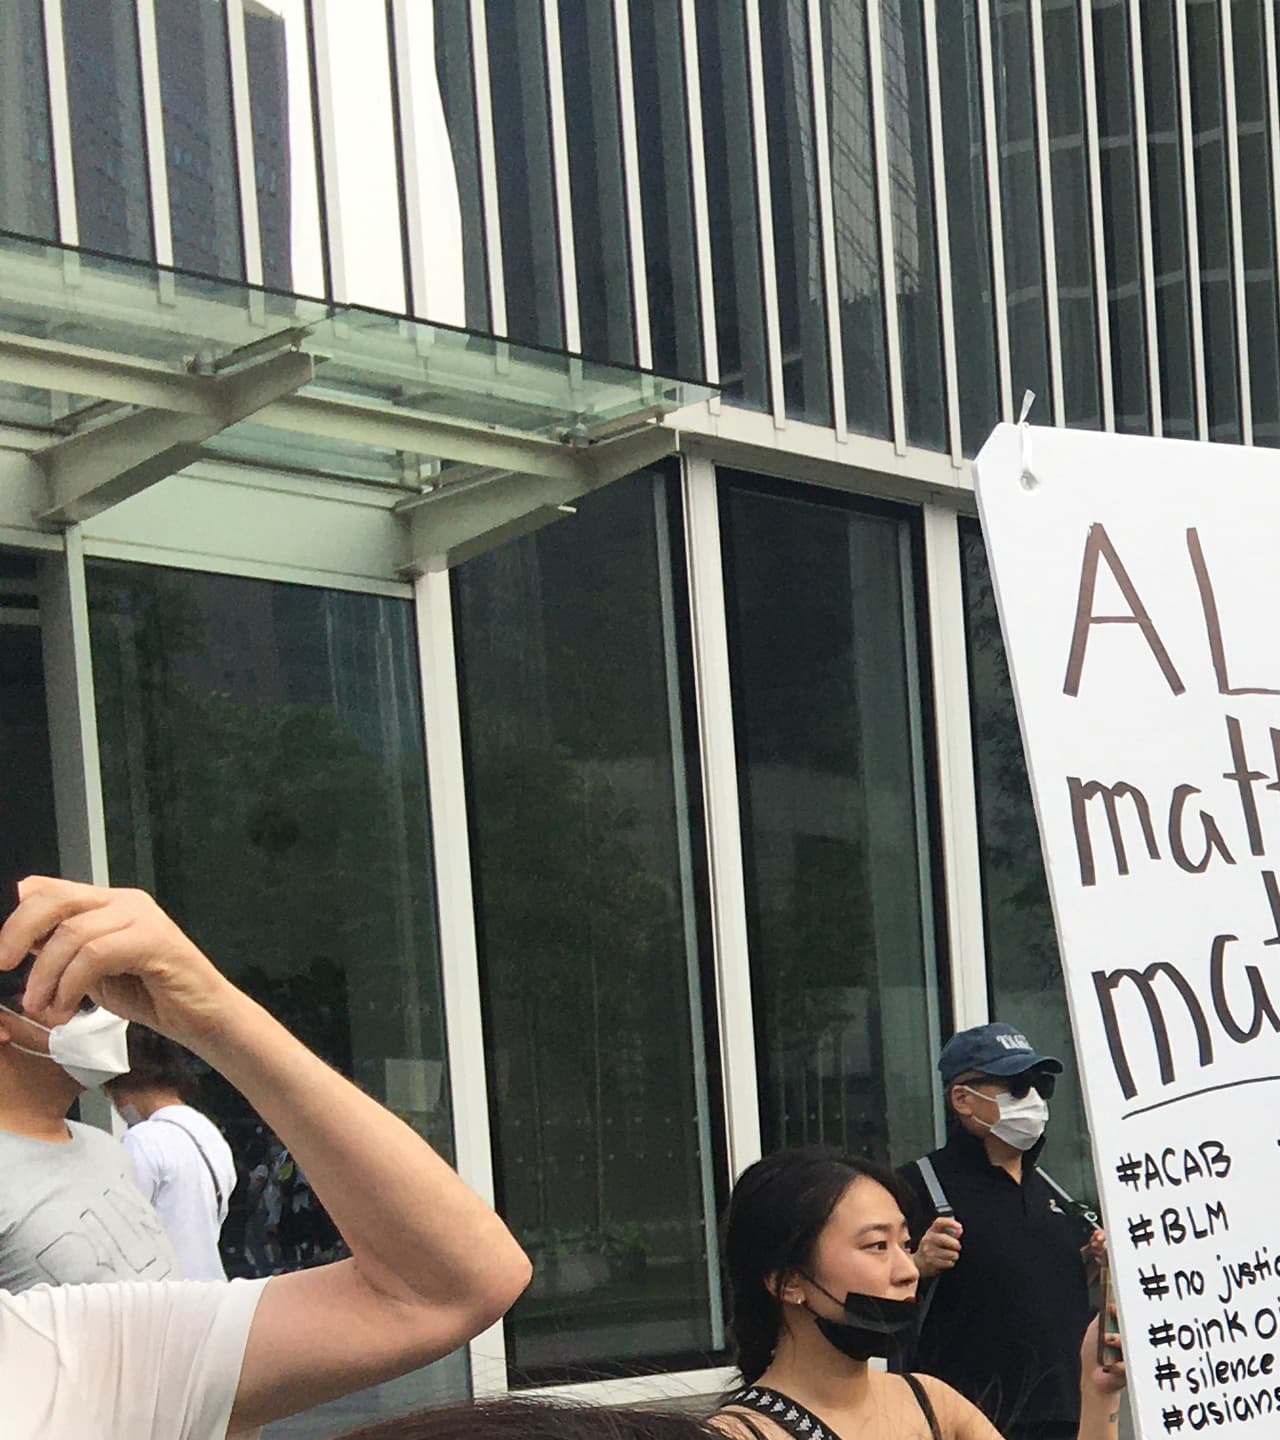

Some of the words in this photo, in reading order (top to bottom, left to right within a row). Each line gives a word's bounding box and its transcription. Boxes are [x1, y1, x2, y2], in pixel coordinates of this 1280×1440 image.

[1116, 1141, 1231, 1191] #ACAB
[1128, 1201, 1228, 1249] #BLM
[1155, 1352, 1274, 1394] #silence
